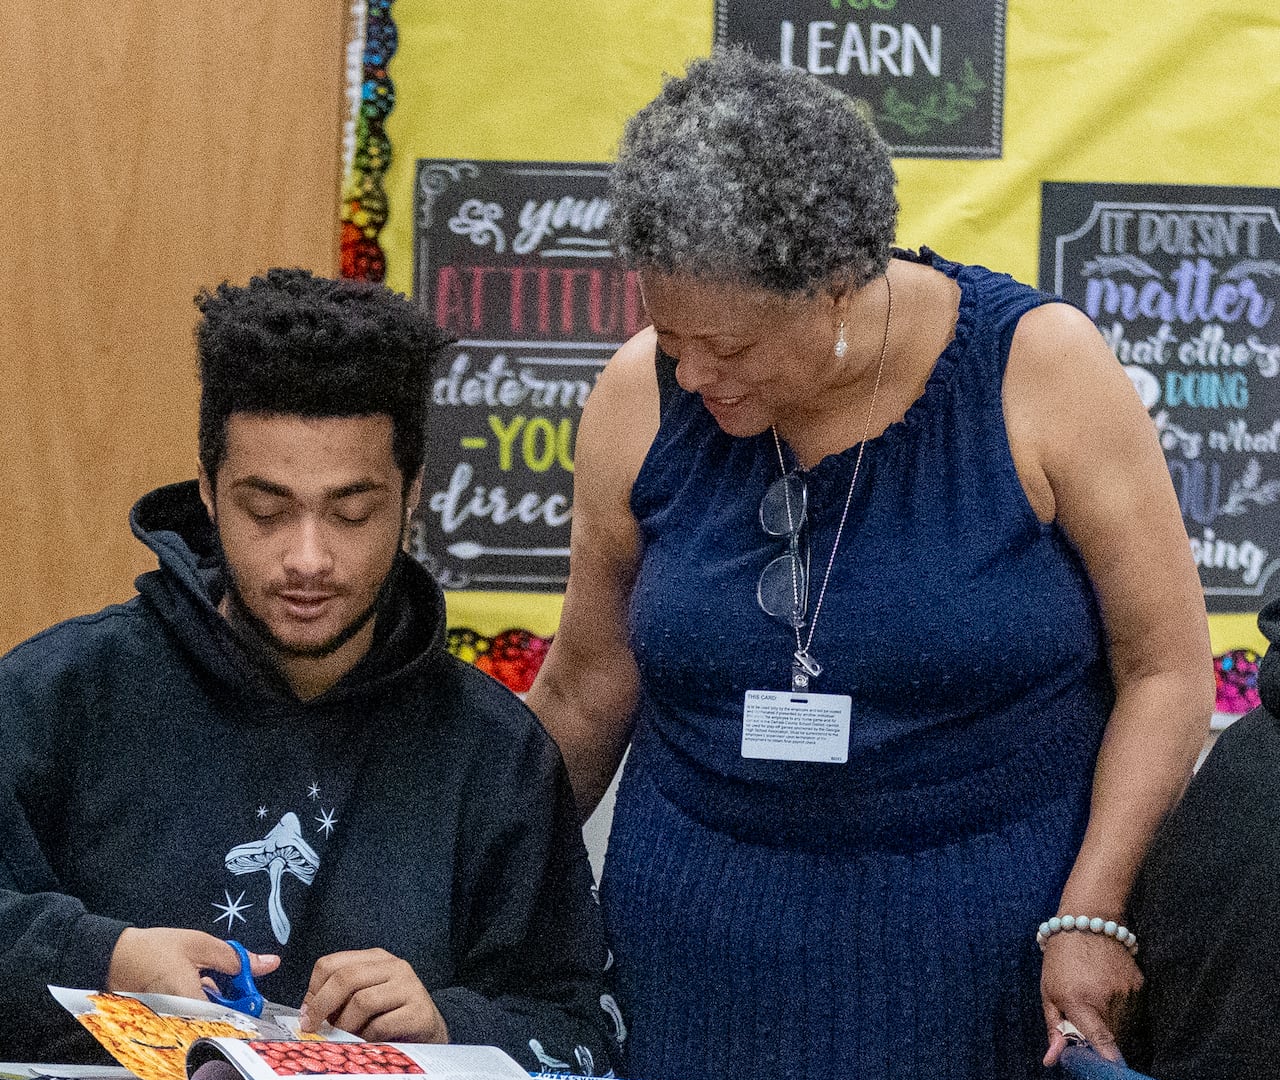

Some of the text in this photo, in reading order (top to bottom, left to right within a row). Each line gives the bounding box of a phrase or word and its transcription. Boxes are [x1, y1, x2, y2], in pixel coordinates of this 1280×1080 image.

[780, 20, 941, 76] LEARN
[1100, 210, 1134, 253] IT
[1085, 258, 1276, 328] matter
[1102, 322, 1177, 366] hat
[1166, 371, 1249, 409] DOING
[429, 463, 573, 533] direc
[1170, 458, 1221, 527] OU
